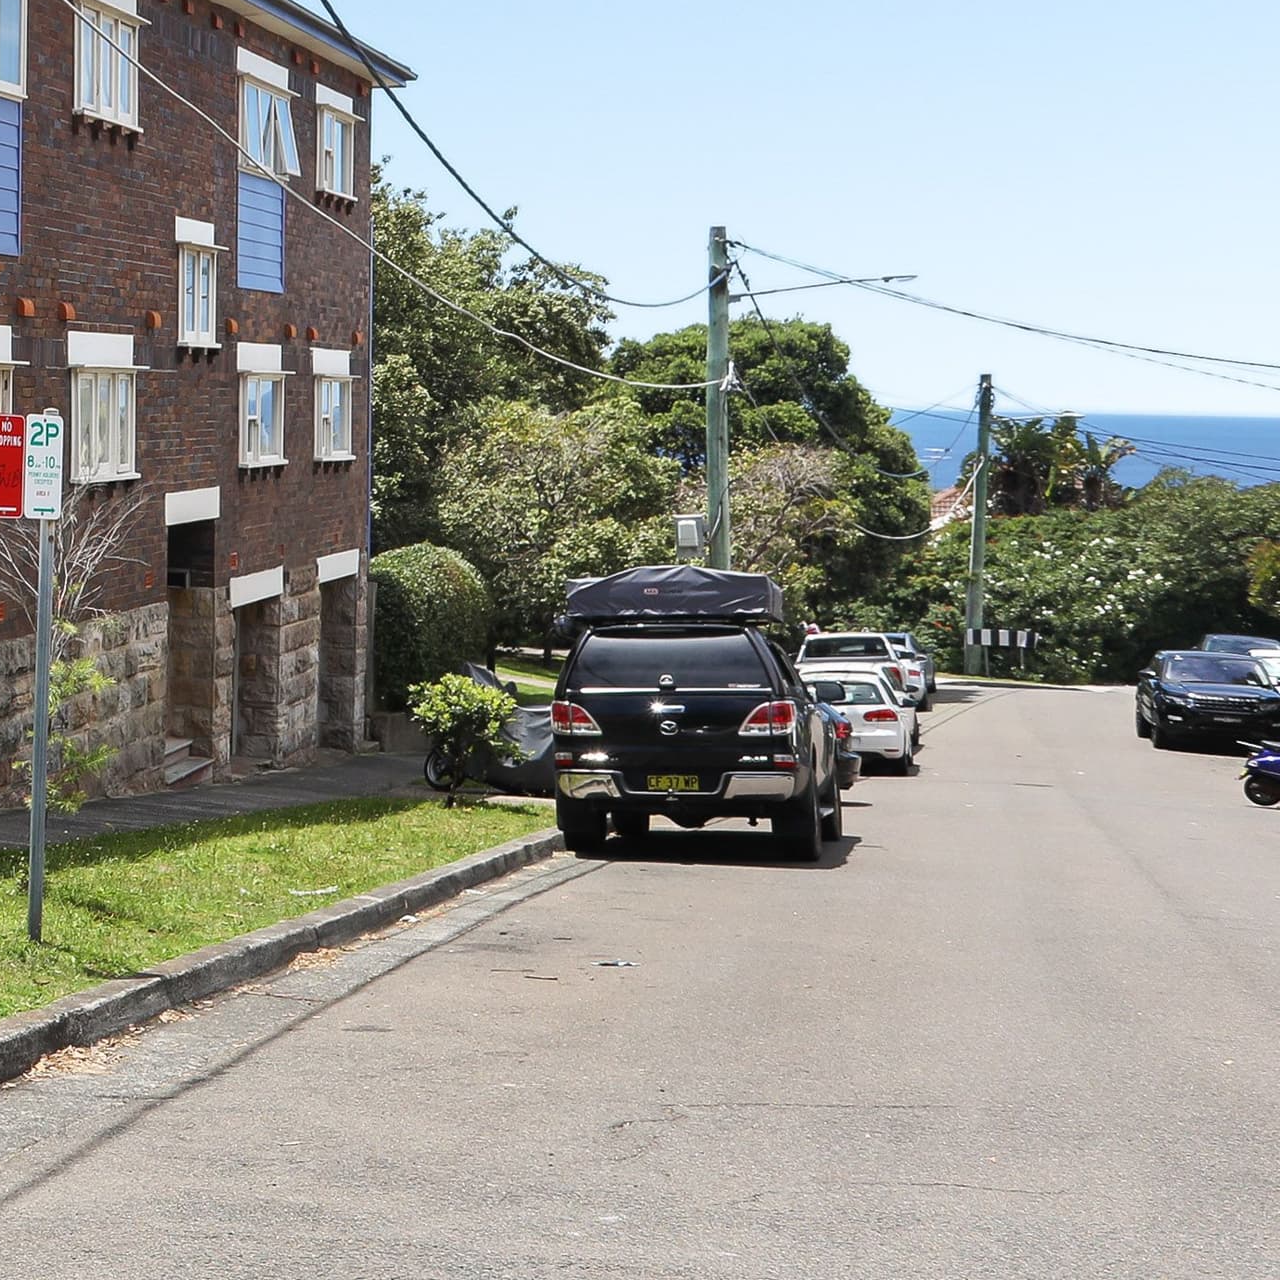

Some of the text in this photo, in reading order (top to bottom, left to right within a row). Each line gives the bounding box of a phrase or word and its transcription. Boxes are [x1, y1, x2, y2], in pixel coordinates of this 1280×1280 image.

[1, 421, 13, 433] NO
[30, 421, 60, 447] 2P
[667, 776, 680, 788] 37
